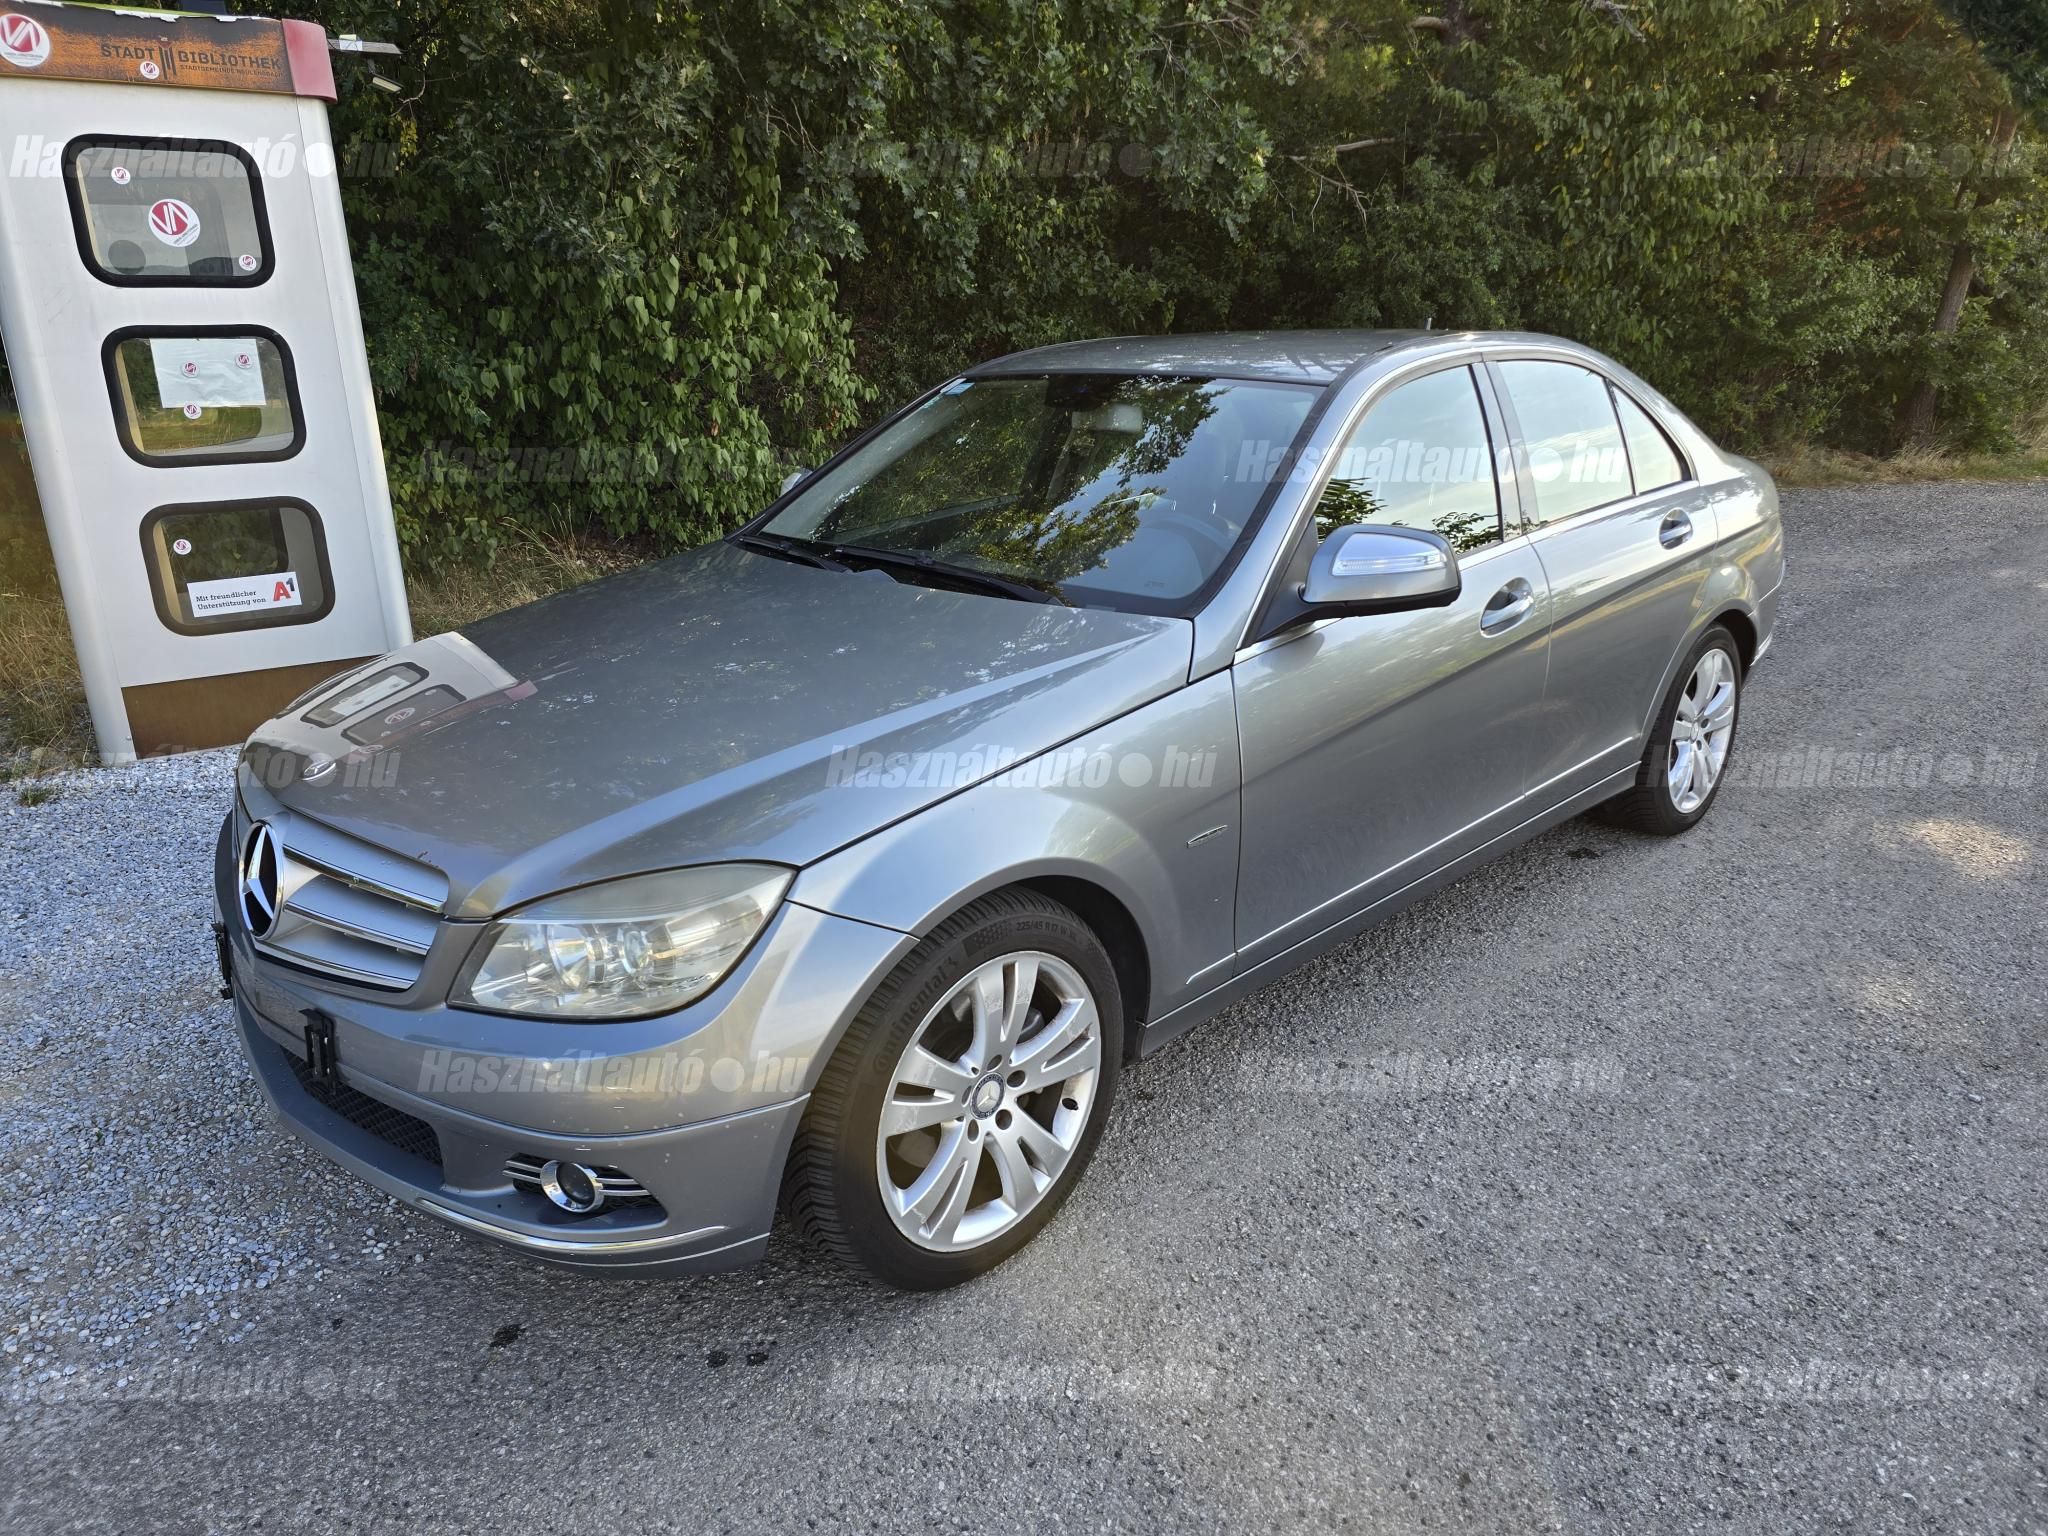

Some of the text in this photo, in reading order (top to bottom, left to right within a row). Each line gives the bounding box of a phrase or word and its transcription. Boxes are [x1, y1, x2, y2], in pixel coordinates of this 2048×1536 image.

[101, 44, 281, 70] STADT BIBLIOTHEK
[210, 590, 257, 600] freundlicher
[273, 577, 295, 602] A1
[197, 599, 251, 610] Unterstützung
